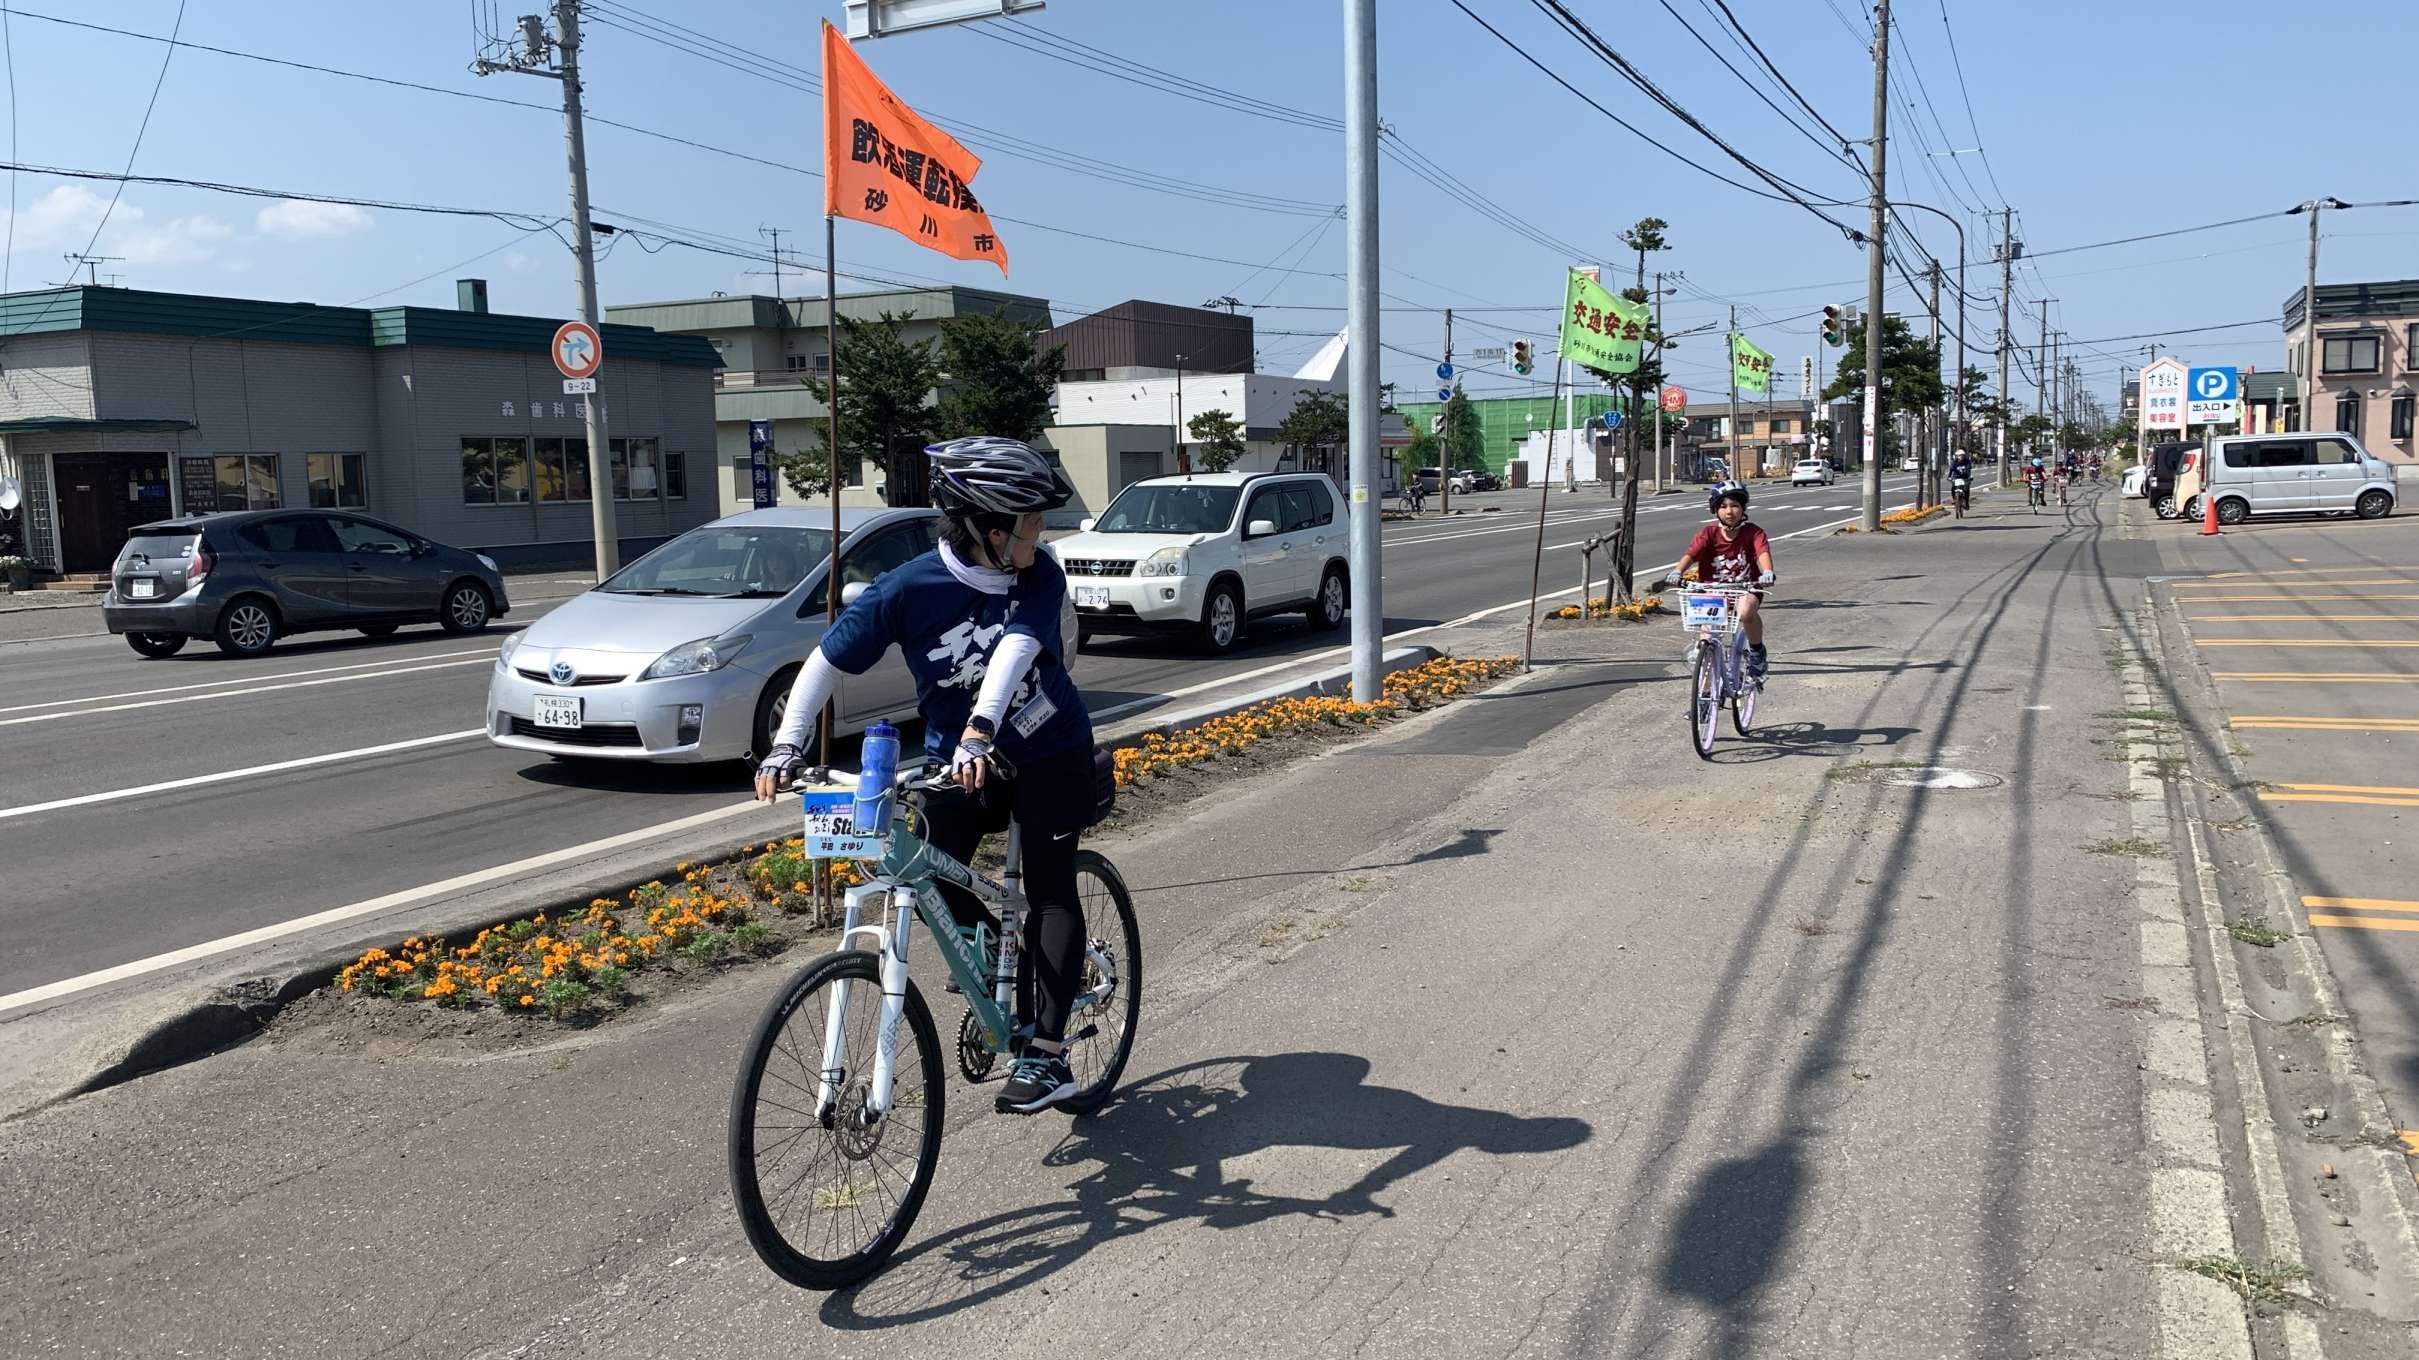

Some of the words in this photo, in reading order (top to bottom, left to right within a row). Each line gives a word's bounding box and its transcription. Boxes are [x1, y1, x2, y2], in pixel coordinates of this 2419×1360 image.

[864, 188, 994, 253] 砂川市
[1572, 300, 1641, 340] 交通安全
[568, 382, 591, 391] 9-22
[2193, 403, 2220, 411] 出入口
[1706, 607, 1719, 617] 40
[544, 710, 578, 726] 64-98
